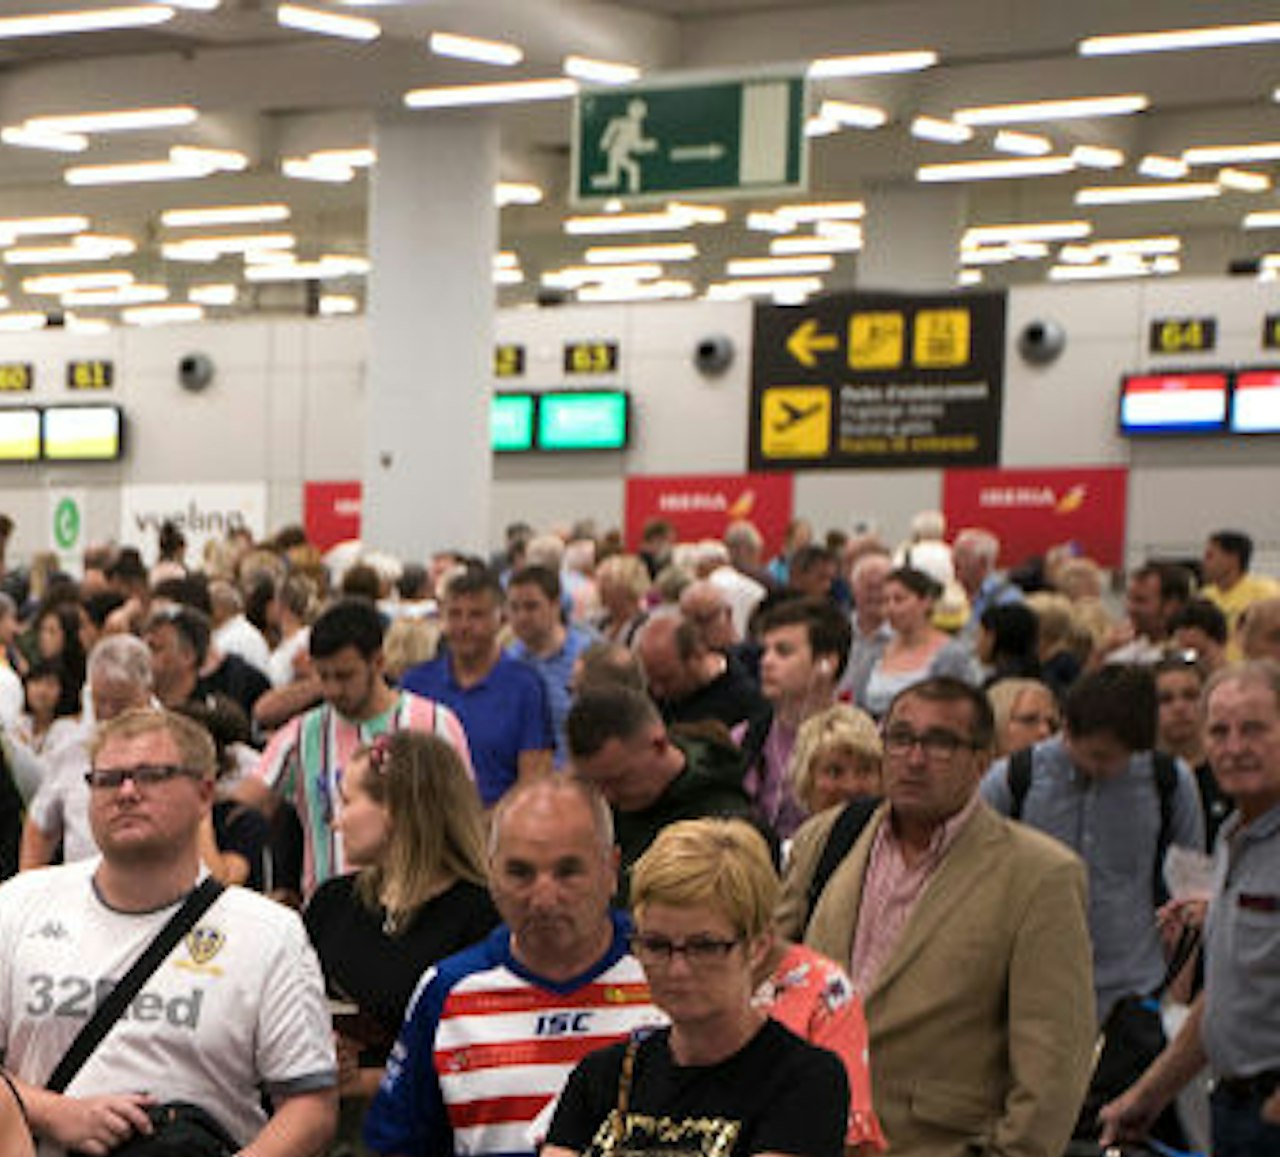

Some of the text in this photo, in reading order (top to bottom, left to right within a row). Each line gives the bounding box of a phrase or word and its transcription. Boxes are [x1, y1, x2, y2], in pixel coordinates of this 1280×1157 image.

[1161, 320, 1203, 351] 64
[572, 342, 609, 373] 63
[135, 498, 245, 540] veling
[535, 1012, 596, 1036] ISC
